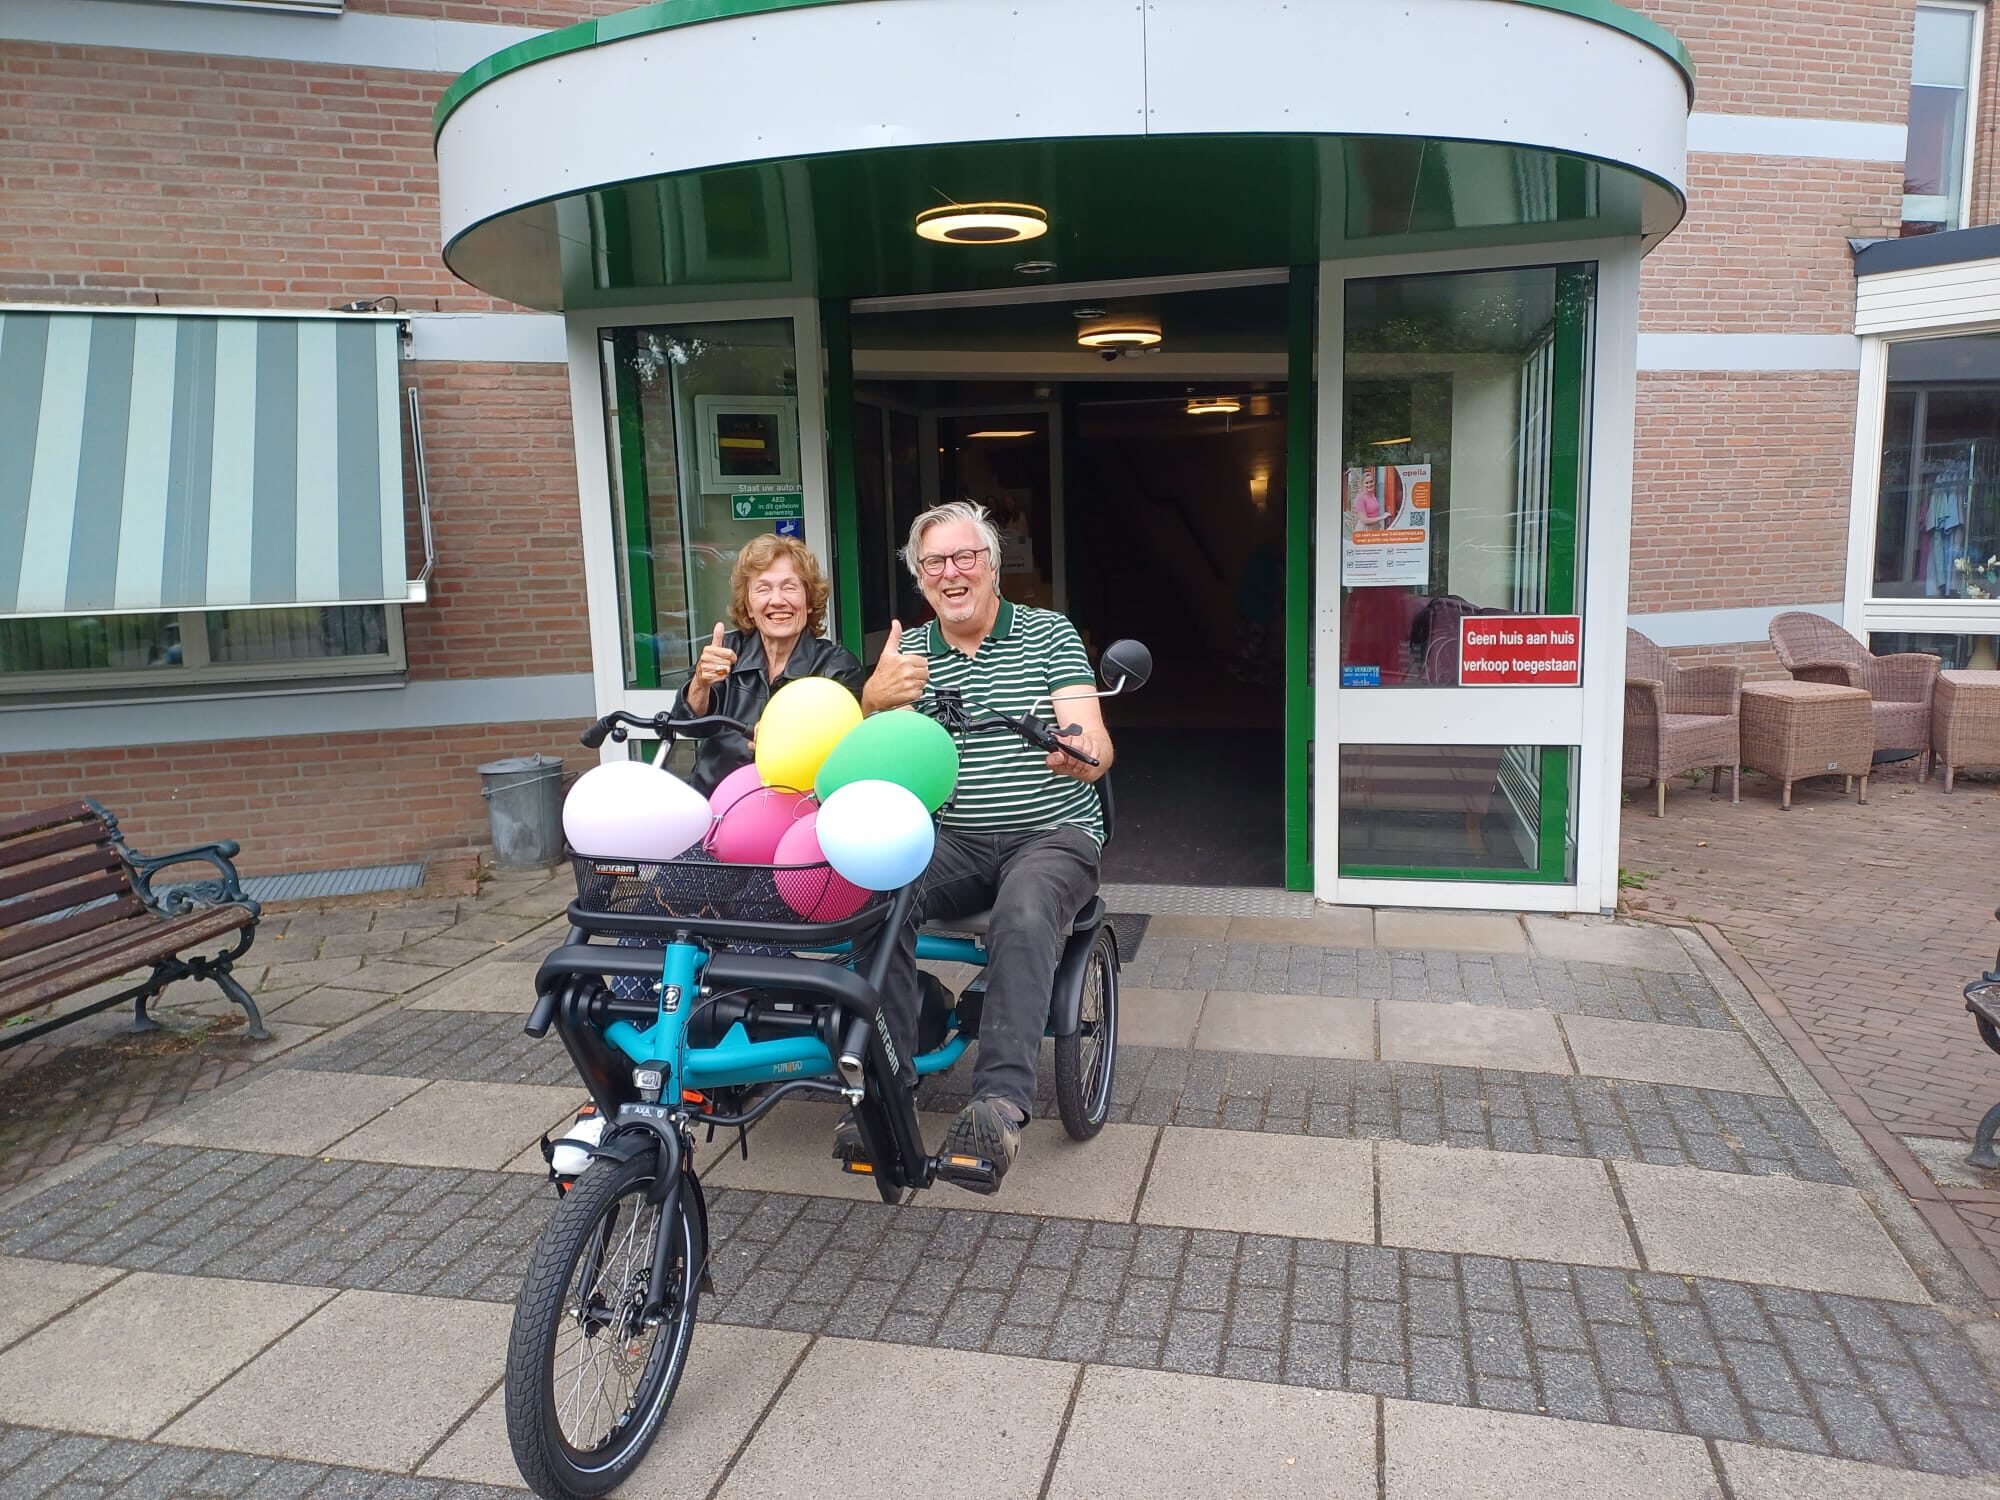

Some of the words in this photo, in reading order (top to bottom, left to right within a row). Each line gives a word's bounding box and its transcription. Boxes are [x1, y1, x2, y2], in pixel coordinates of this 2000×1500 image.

[1402, 468, 1427, 477] opella
[1467, 631, 1497, 646] Geen
[1500, 630, 1524, 645] huis
[1526, 633, 1548, 645] aan
[1550, 630, 1575, 645] huis
[1463, 657, 1510, 675] verkoop
[1512, 657, 1577, 675] toegestaan
[595, 863, 635, 873] vanraam
[875, 1005, 900, 1077] vanraam
[633, 1105, 651, 1115] AXA
